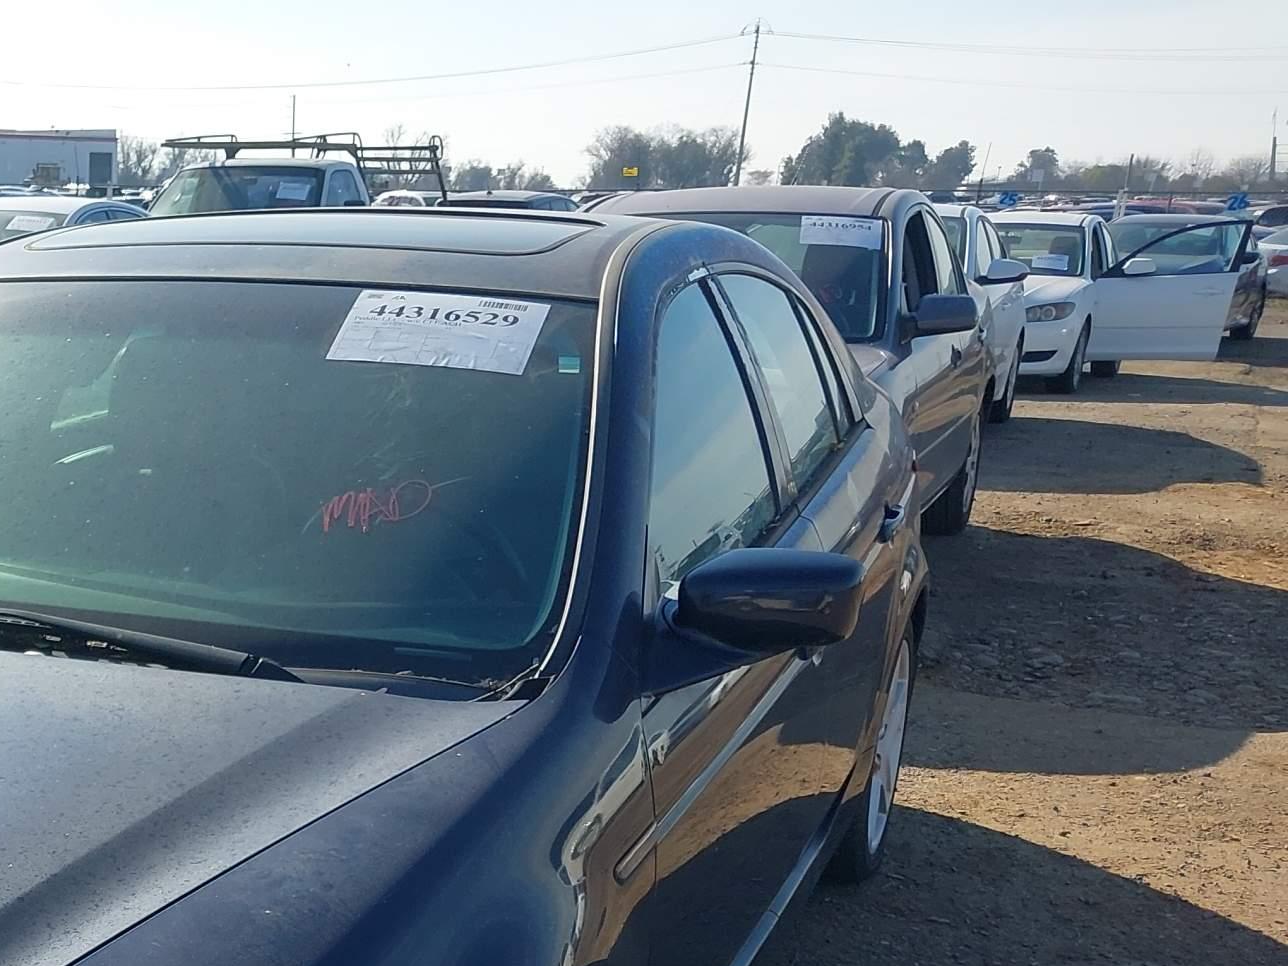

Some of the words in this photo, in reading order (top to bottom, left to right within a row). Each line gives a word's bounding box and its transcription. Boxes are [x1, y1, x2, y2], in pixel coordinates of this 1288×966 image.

[1000, 191, 1017, 206] 25
[1227, 192, 1249, 211] 26
[369, 304, 520, 328] 44316529
